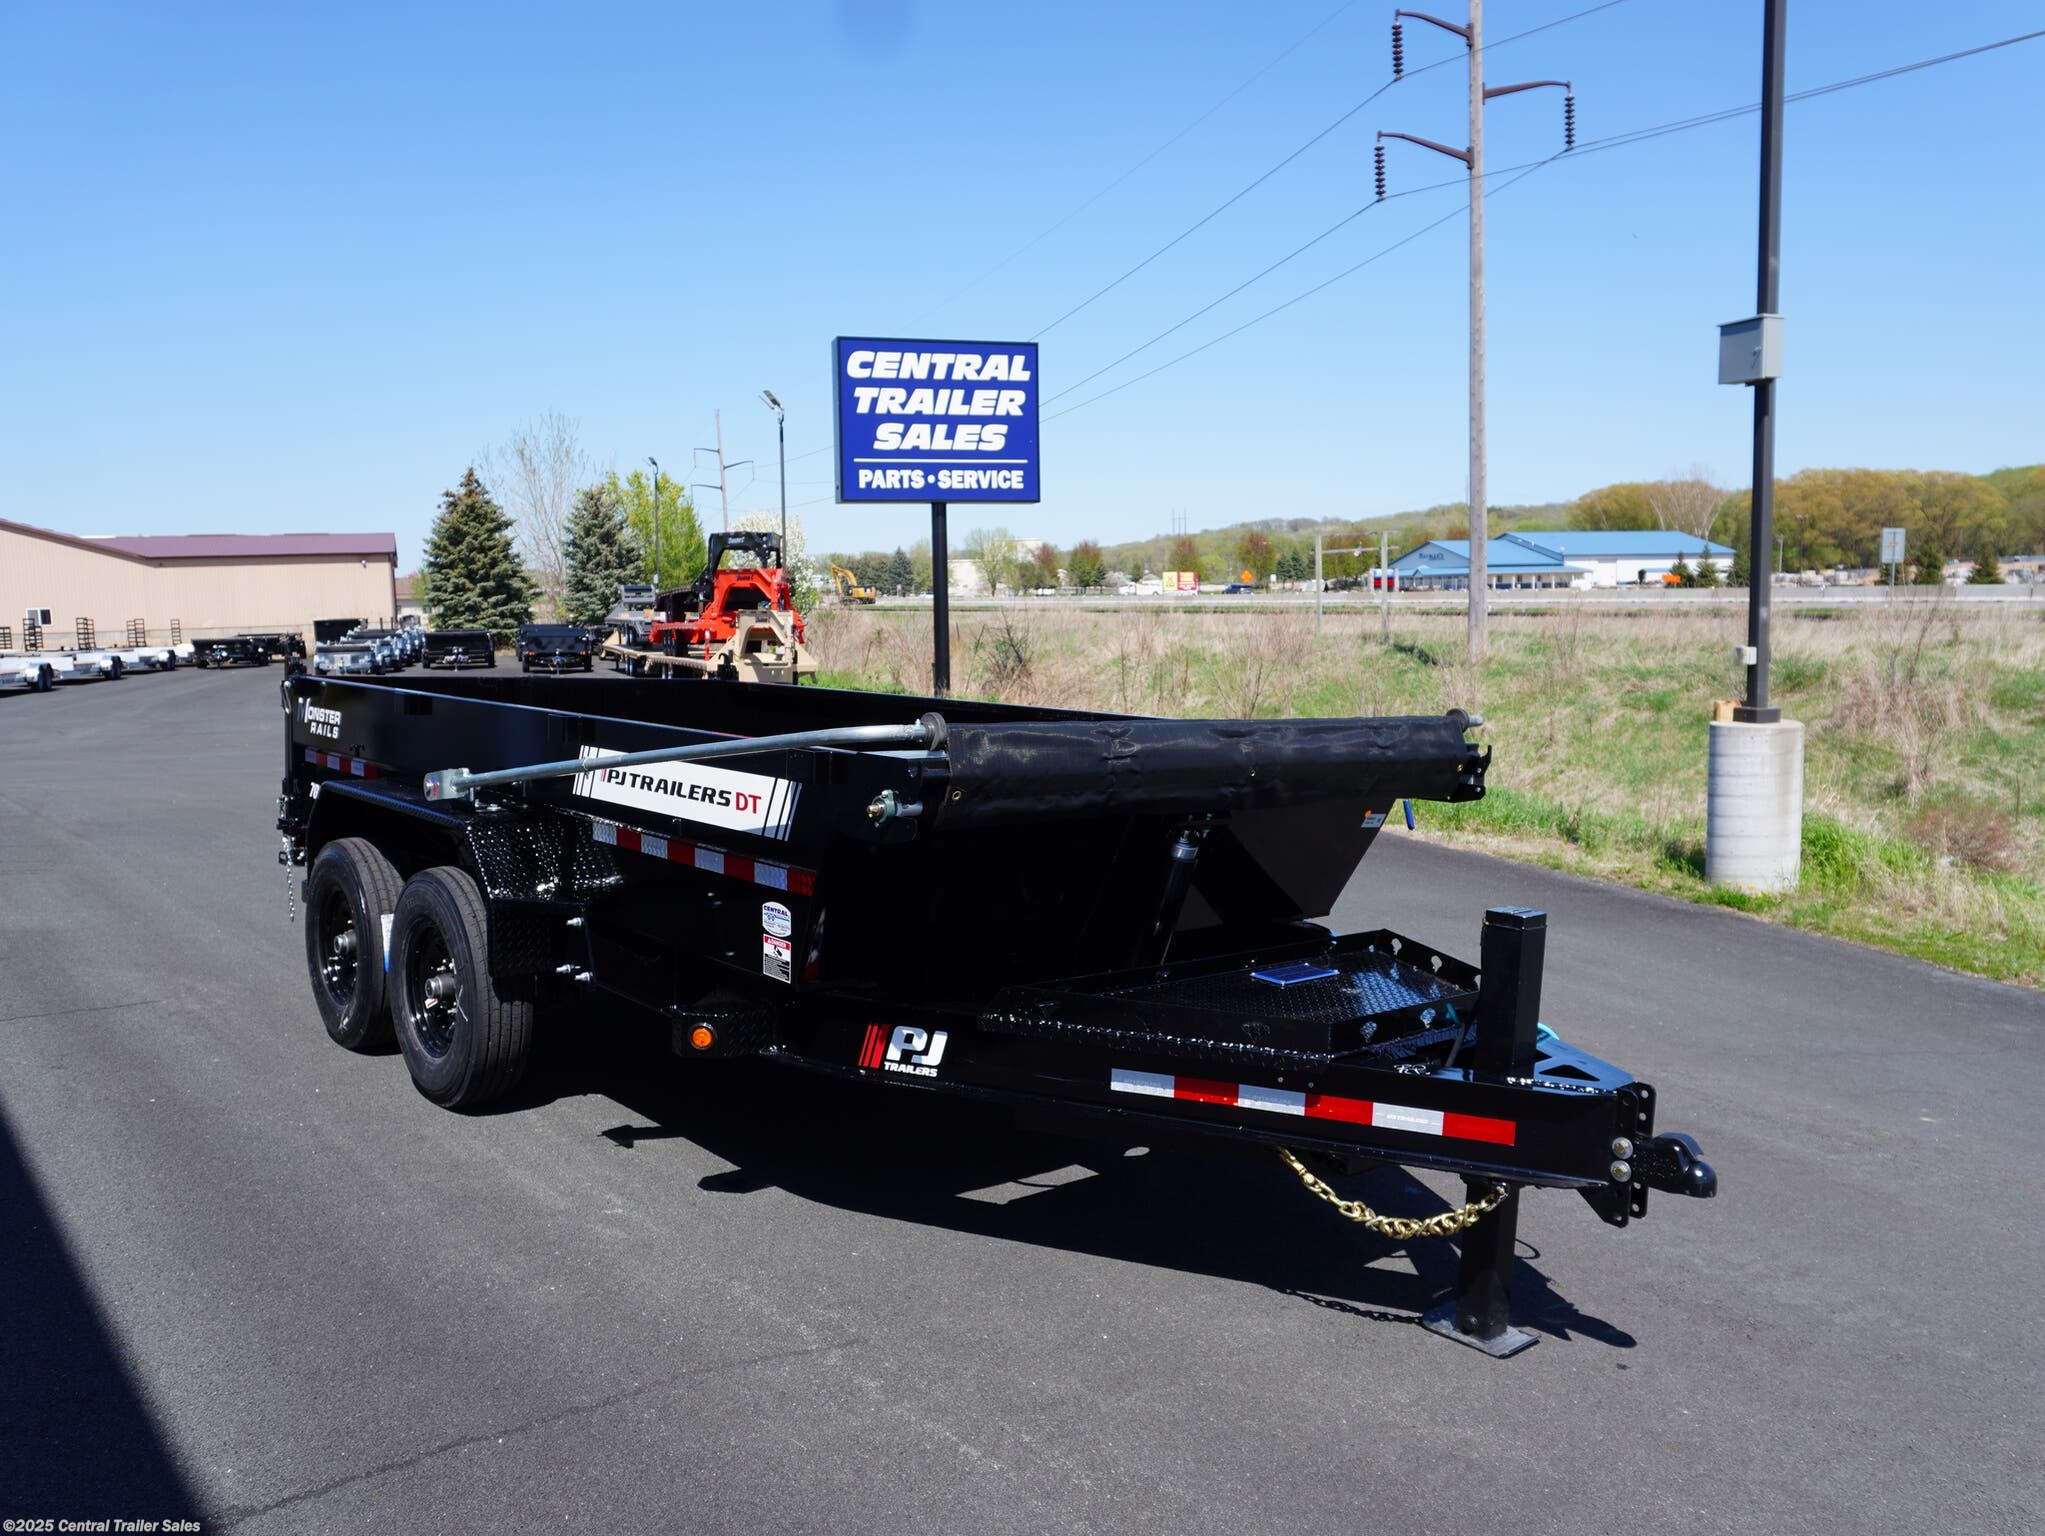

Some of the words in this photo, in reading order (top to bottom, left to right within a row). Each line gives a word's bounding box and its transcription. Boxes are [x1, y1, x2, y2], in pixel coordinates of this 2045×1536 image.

[846, 350, 1031, 381] CENTRAL
[853, 387, 1026, 416] TRAILER
[873, 422, 1008, 451] SALES
[296, 697, 342, 726] MONSTER
[310, 721, 340, 739] RAILS
[735, 792, 762, 814] DT
[886, 1025, 948, 1067] PJ
[884, 1061, 938, 1078] TRAILERS
